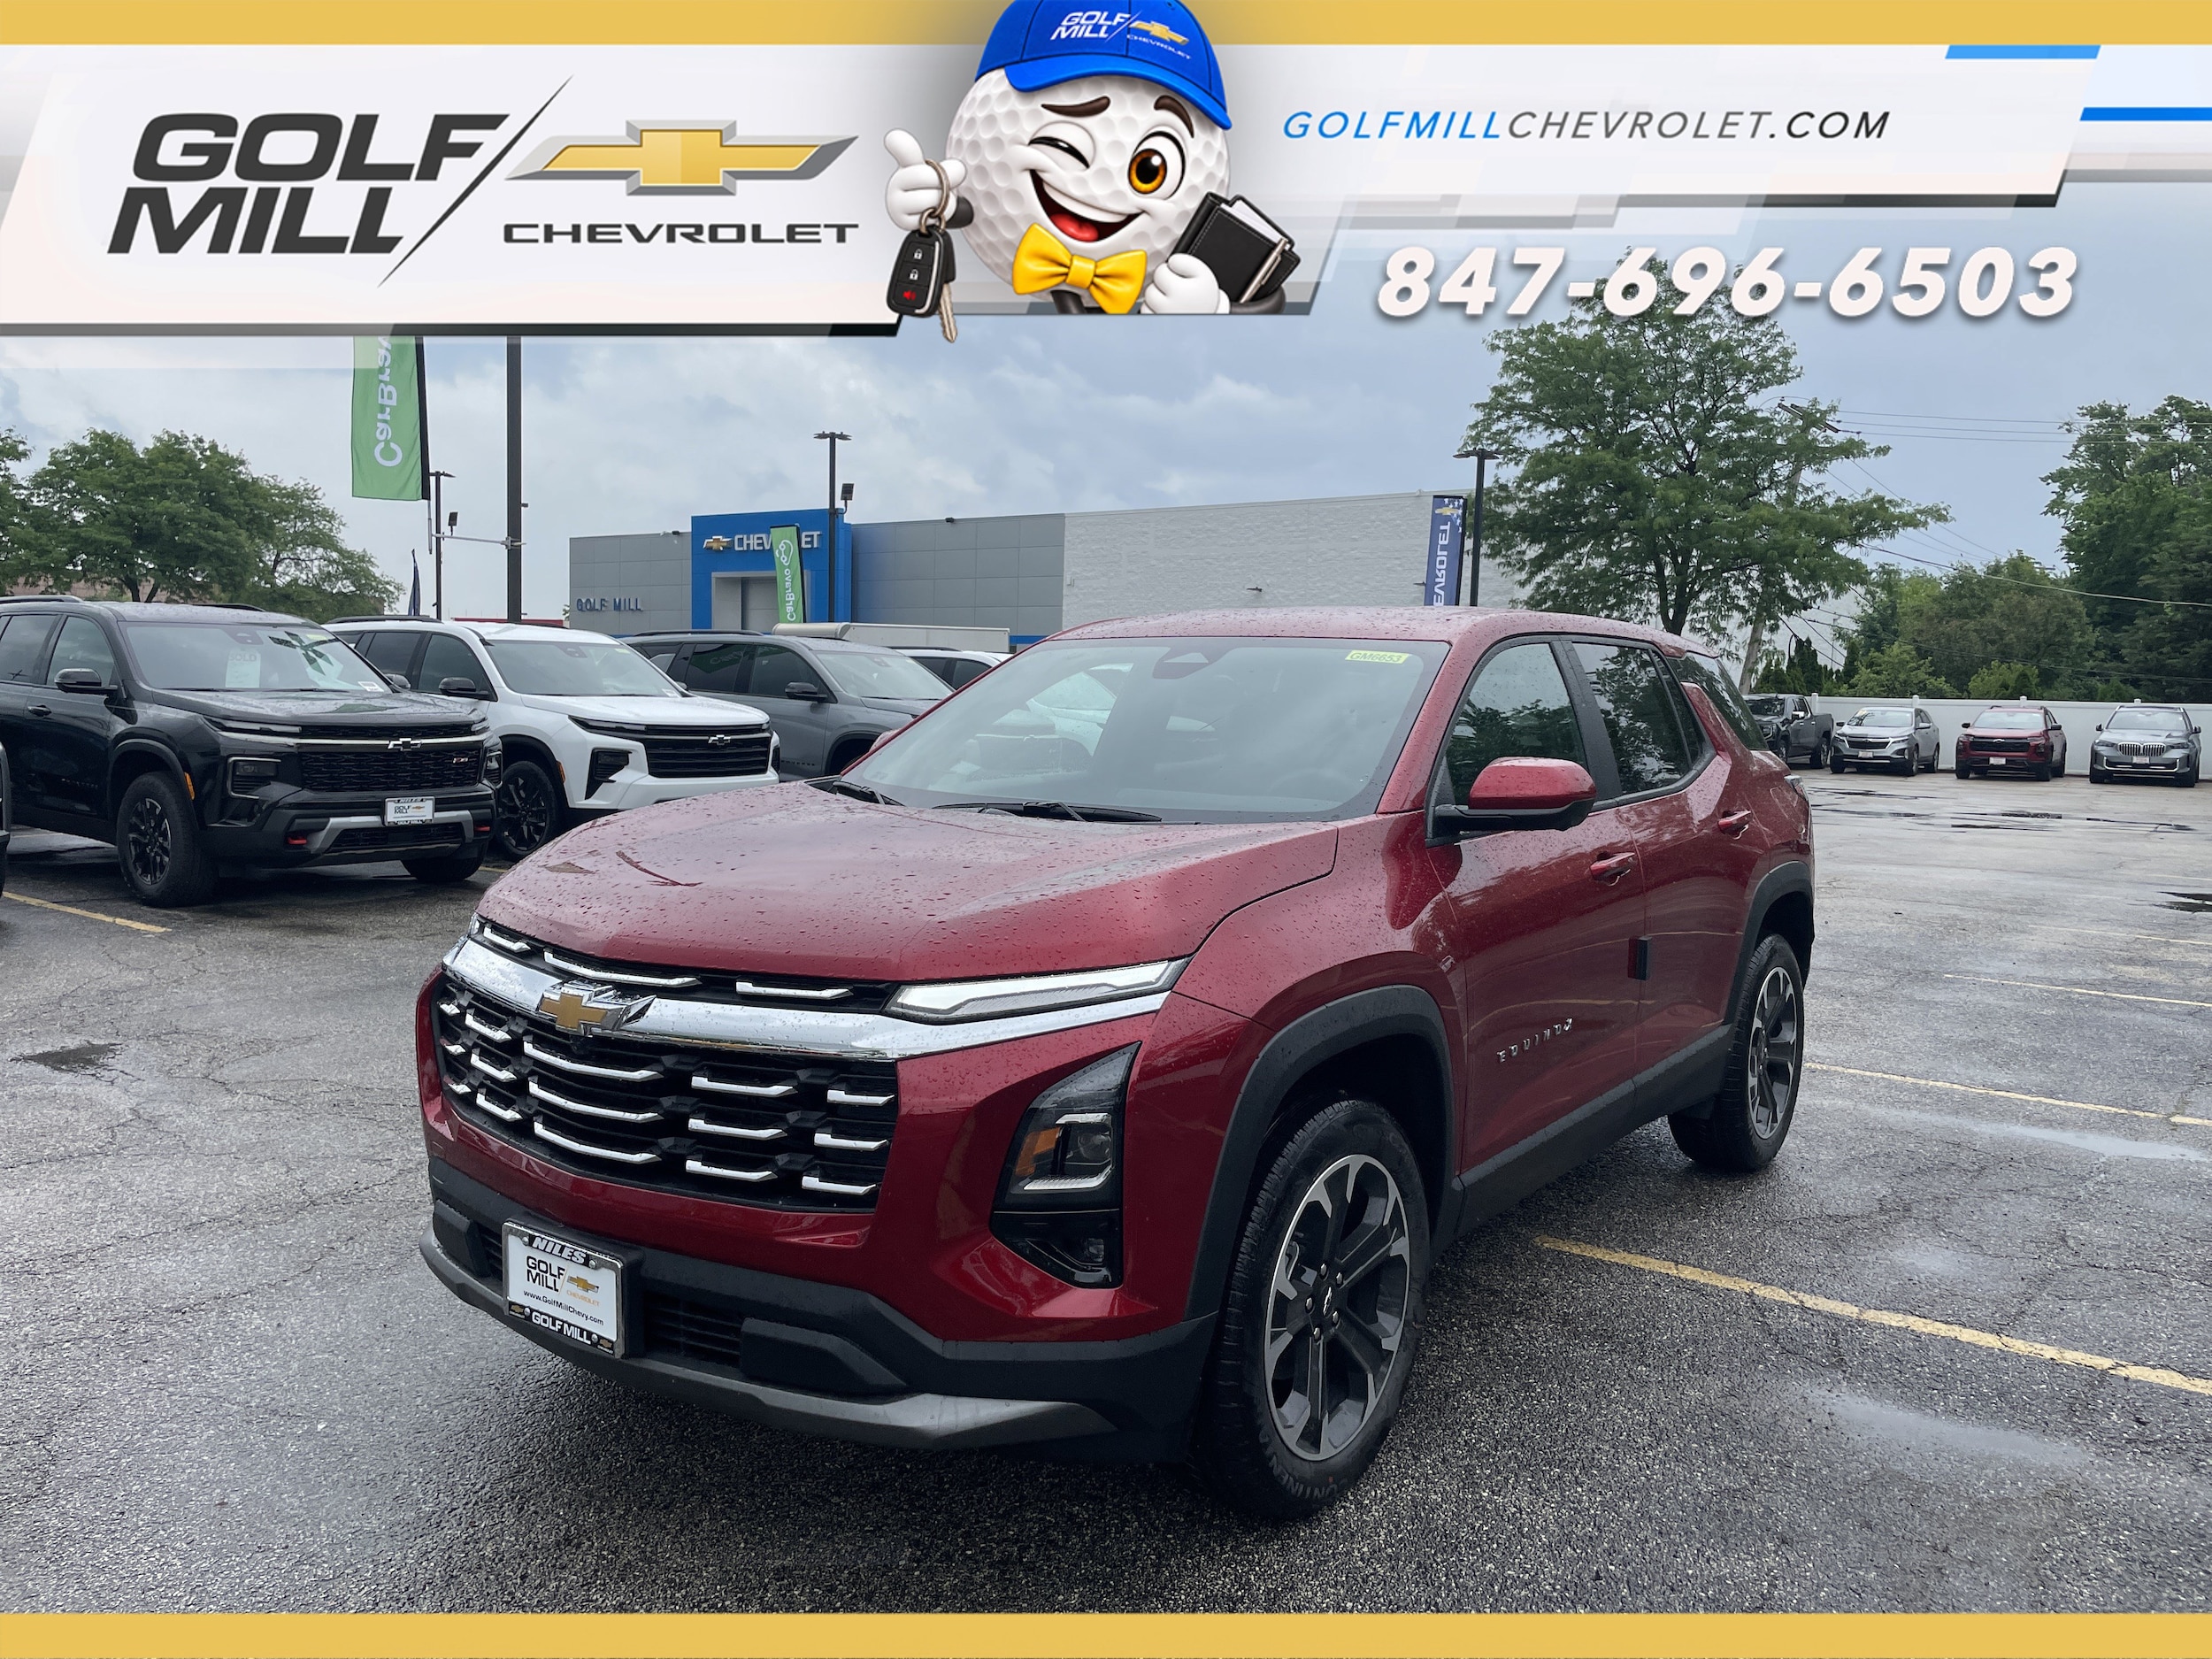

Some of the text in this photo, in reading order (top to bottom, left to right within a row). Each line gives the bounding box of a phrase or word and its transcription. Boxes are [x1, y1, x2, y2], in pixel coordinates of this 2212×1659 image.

[734, 531, 823, 551] CHEVET
[577, 597, 643, 612] GOLF MILL
[1349, 652, 1402, 663] GM6653
[1496, 1018, 1573, 1063] EQUINOX
[532, 1236, 587, 1264] NILES
[526, 1256, 565, 1279] GOLF
[526, 1269, 559, 1293] MILL
[523, 1290, 604, 1325] www.GolfMillChevy.com
[532, 1312, 564, 1333] GOLF
[563, 1324, 592, 1345] MILL
